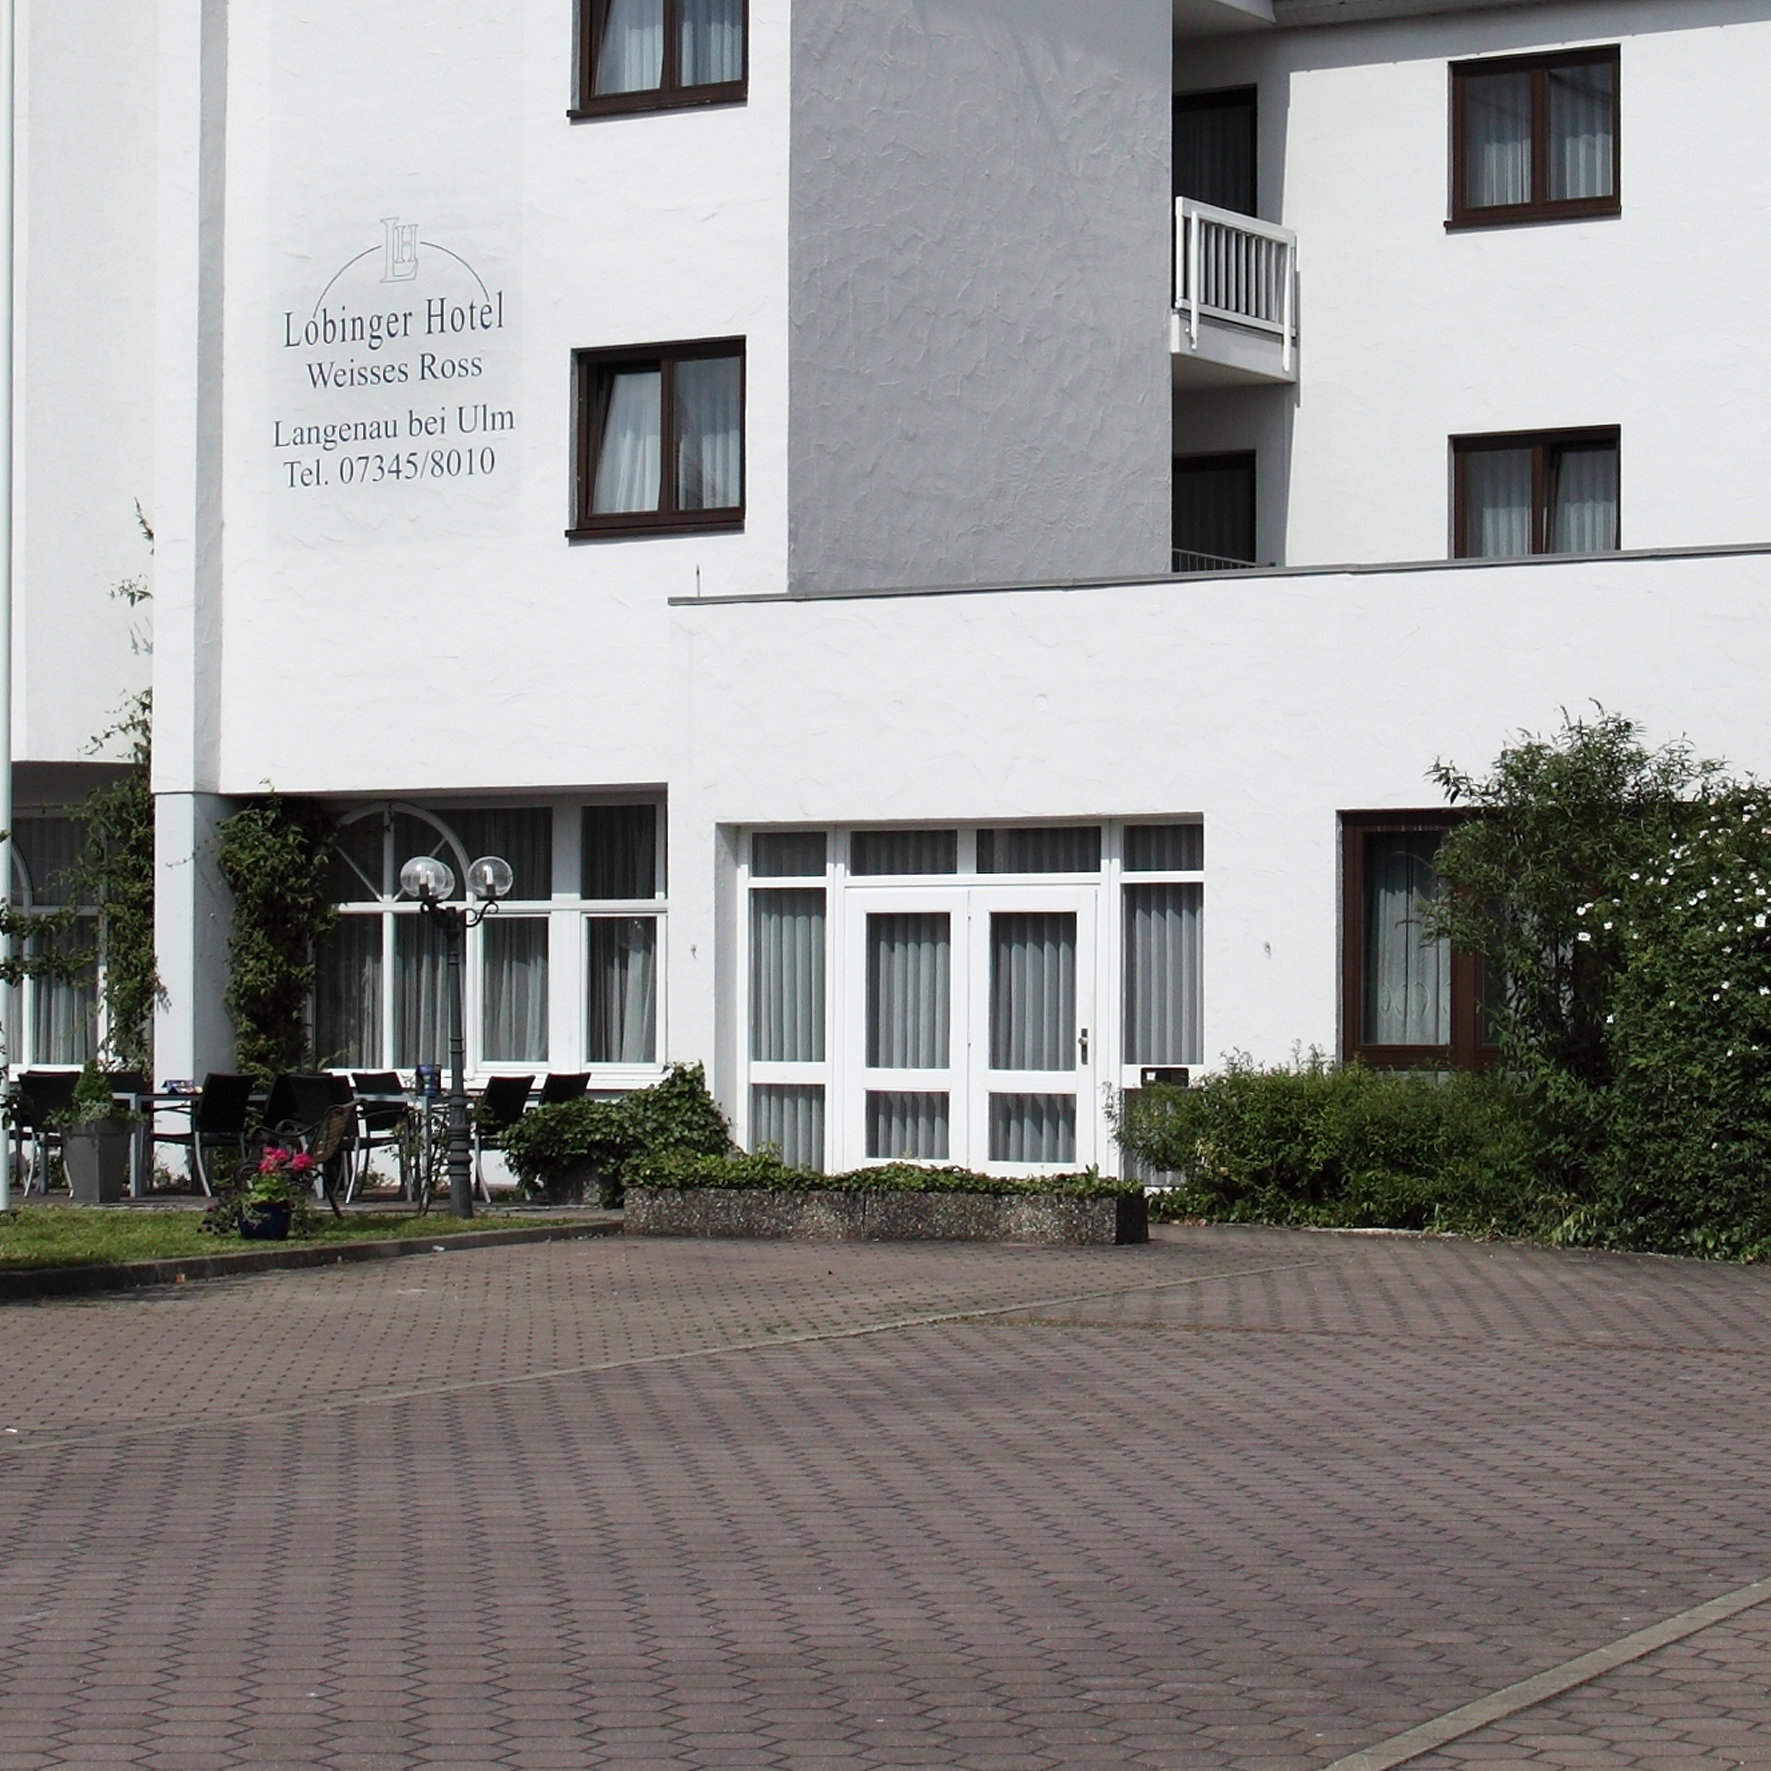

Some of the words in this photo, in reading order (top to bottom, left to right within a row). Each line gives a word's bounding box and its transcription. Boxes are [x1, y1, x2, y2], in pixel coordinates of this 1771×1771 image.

[283, 305, 413, 350] Lobinger
[425, 290, 504, 335] Hotel
[306, 358, 409, 389] Weisses
[418, 352, 483, 381] Ross
[273, 420, 398, 451] Langenau
[408, 406, 446, 437] bei
[458, 403, 515, 434] Ulm
[283, 458, 329, 488] Tel.
[339, 446, 495, 484] 07345/8010
